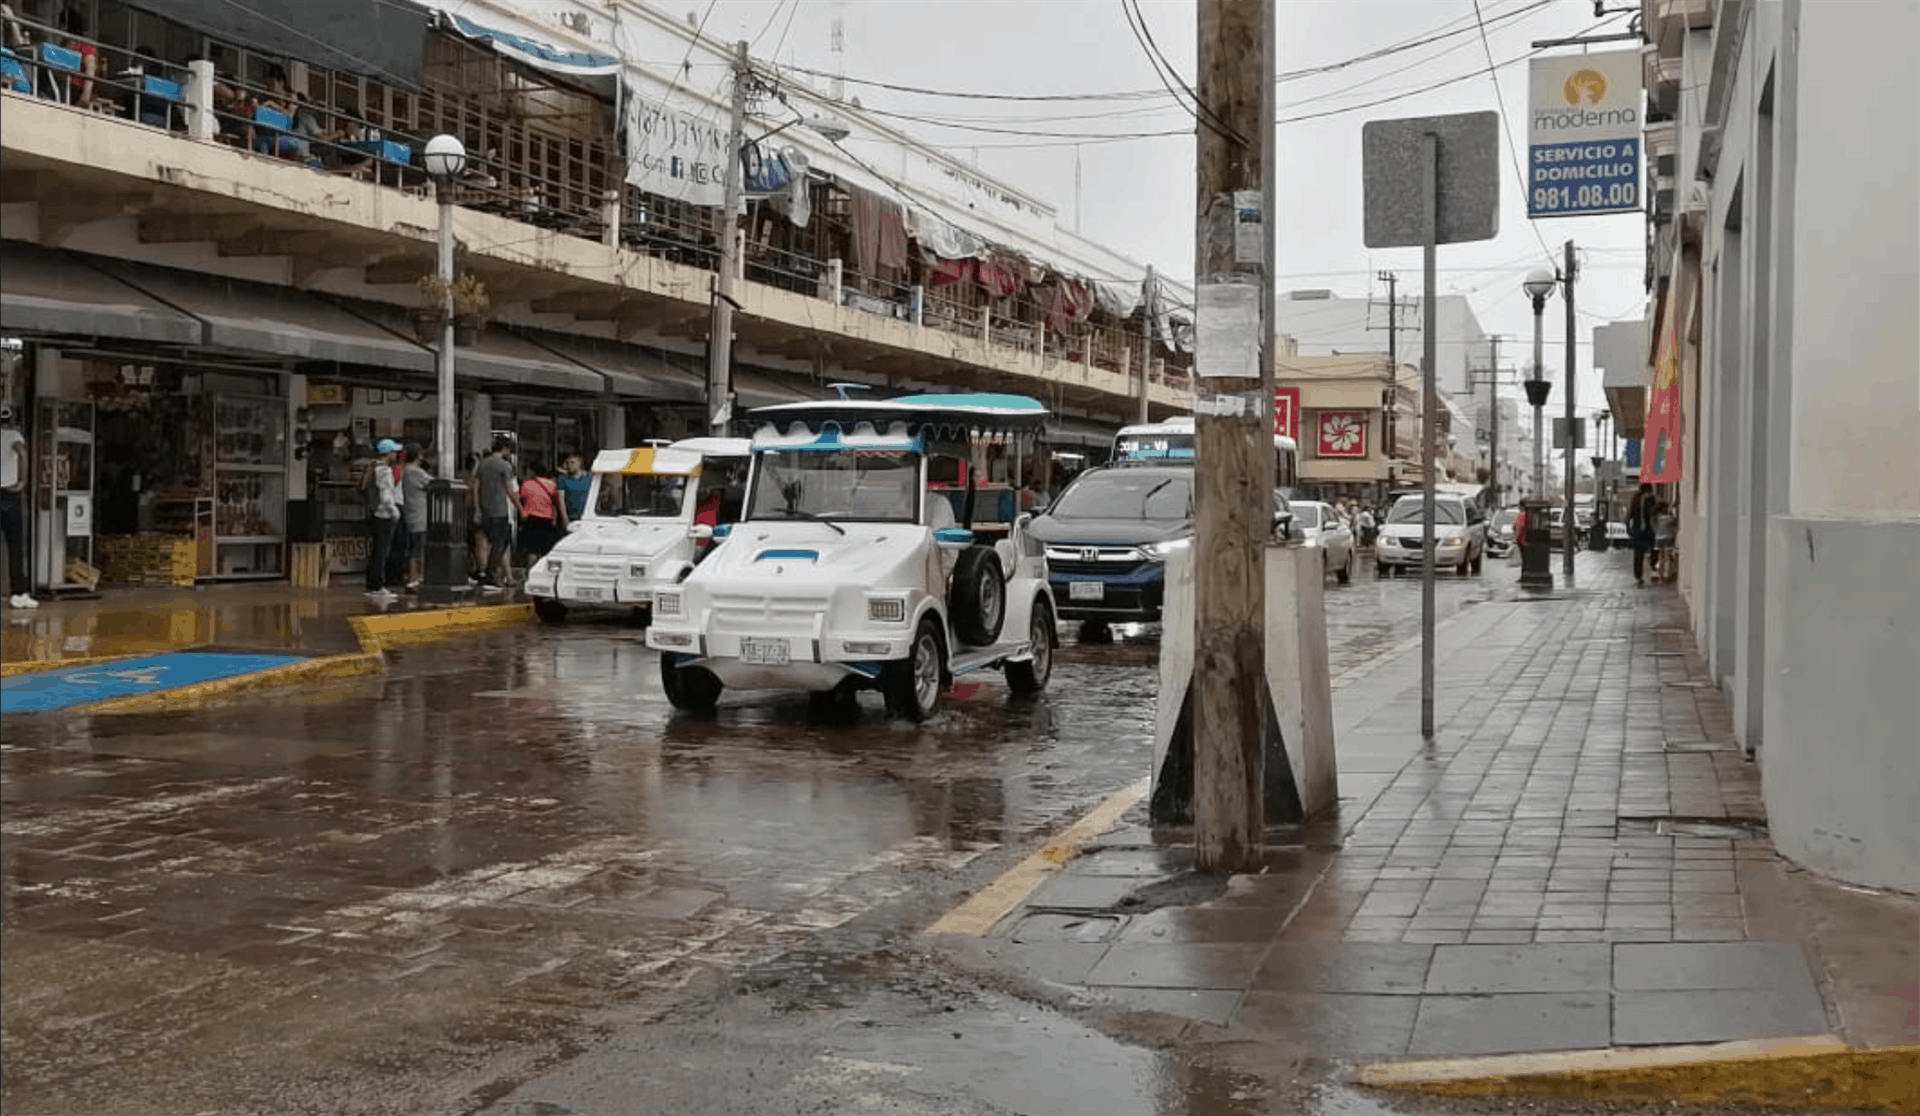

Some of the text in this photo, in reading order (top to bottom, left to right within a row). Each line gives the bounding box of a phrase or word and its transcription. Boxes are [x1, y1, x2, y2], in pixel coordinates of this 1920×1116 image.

[1534, 143, 1634, 163] SERVICIO A
[1534, 162, 1634, 181] DOMICILIO
[1533, 182, 1635, 210] 981.08.00
